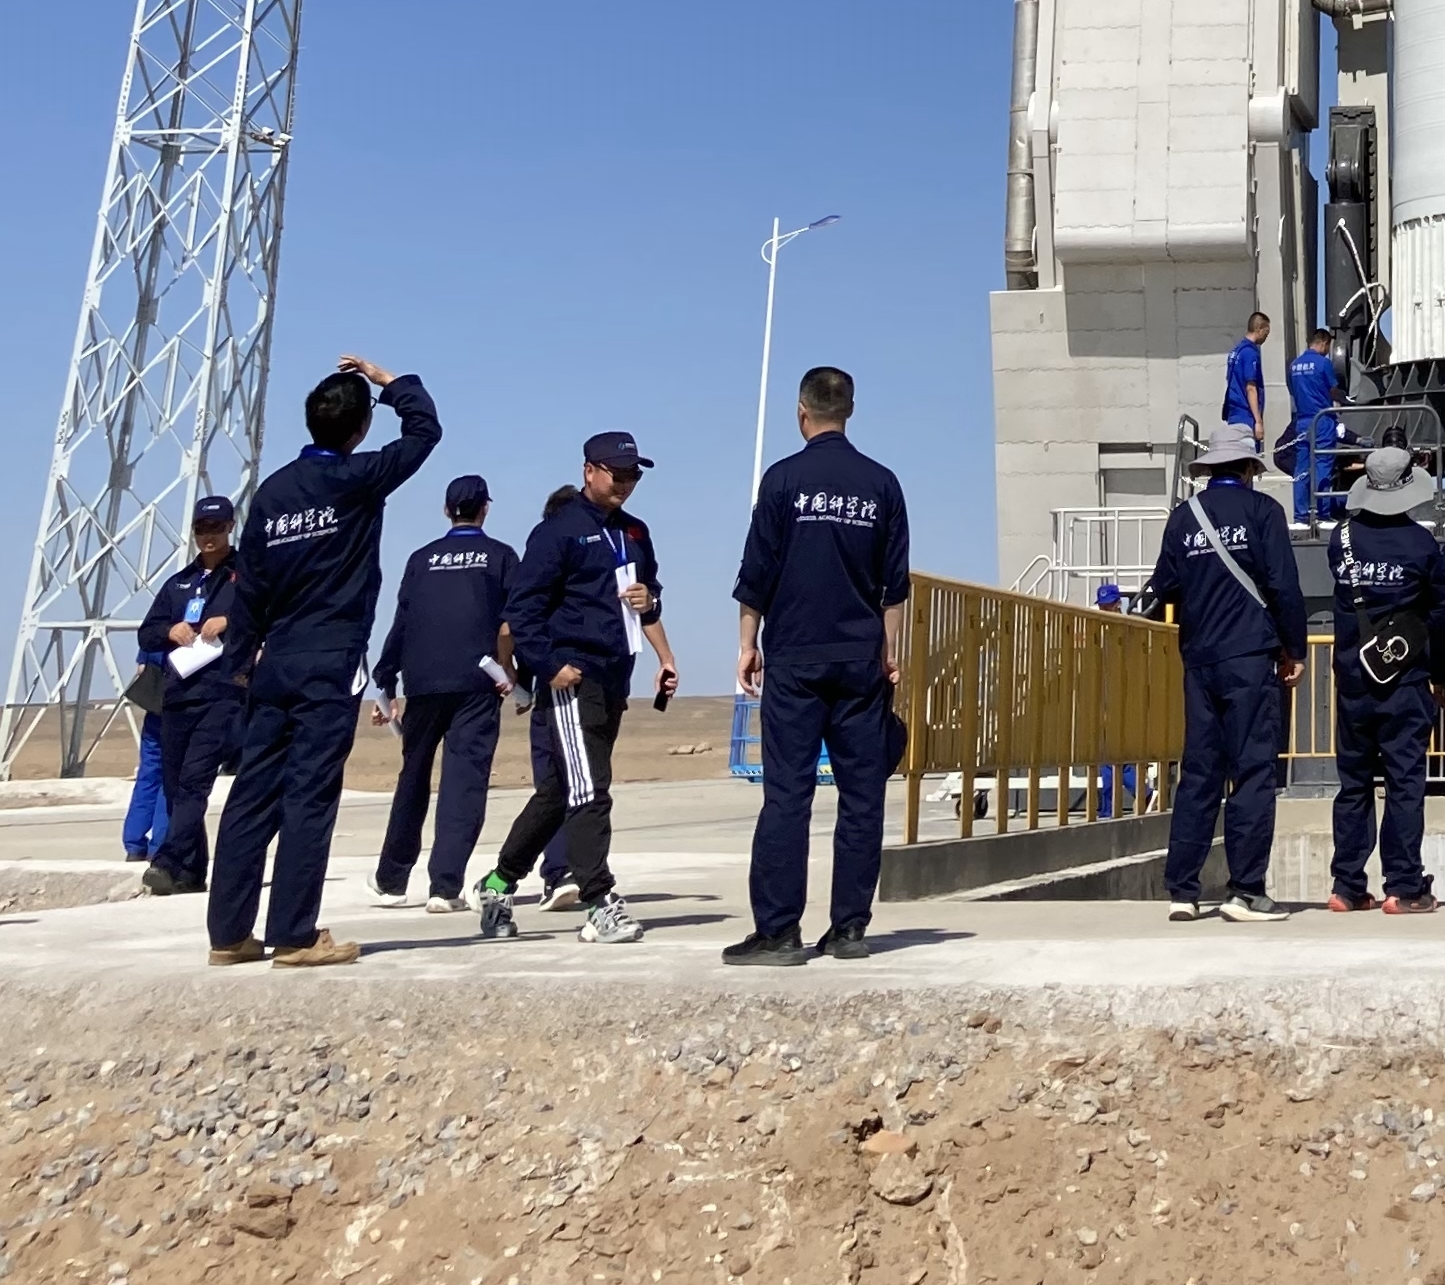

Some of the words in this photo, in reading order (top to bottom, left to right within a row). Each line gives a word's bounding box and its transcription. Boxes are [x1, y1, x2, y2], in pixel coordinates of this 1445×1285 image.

[794, 491, 877, 520] 中国科学院
[264, 505, 339, 539] 中国科学院
[1183, 524, 1248, 548] 中国学院
[428, 551, 488, 566] 中国科学院
